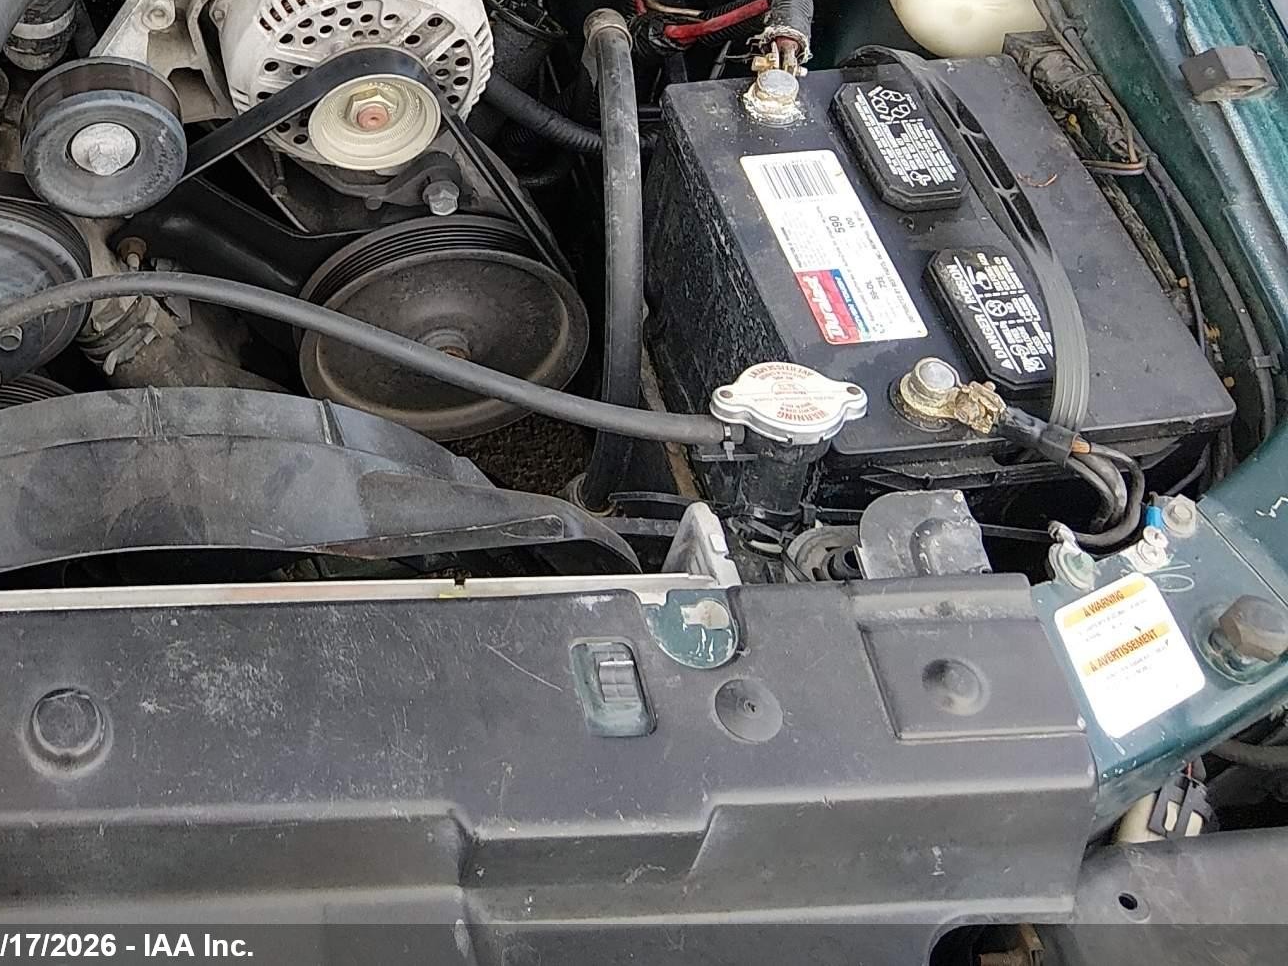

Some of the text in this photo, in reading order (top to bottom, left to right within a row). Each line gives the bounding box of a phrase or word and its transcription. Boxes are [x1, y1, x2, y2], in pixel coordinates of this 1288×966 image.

[827, 214, 846, 234] 590
[945, 263, 977, 303] POISON
[801, 274, 847, 342] Duralast
[973, 312, 1008, 359] DANGER
[777, 409, 826, 423] WARNING
[1090, 590, 1125, 613] WARNING
[1098, 628, 1160, 667] AVERTISSEMENT
